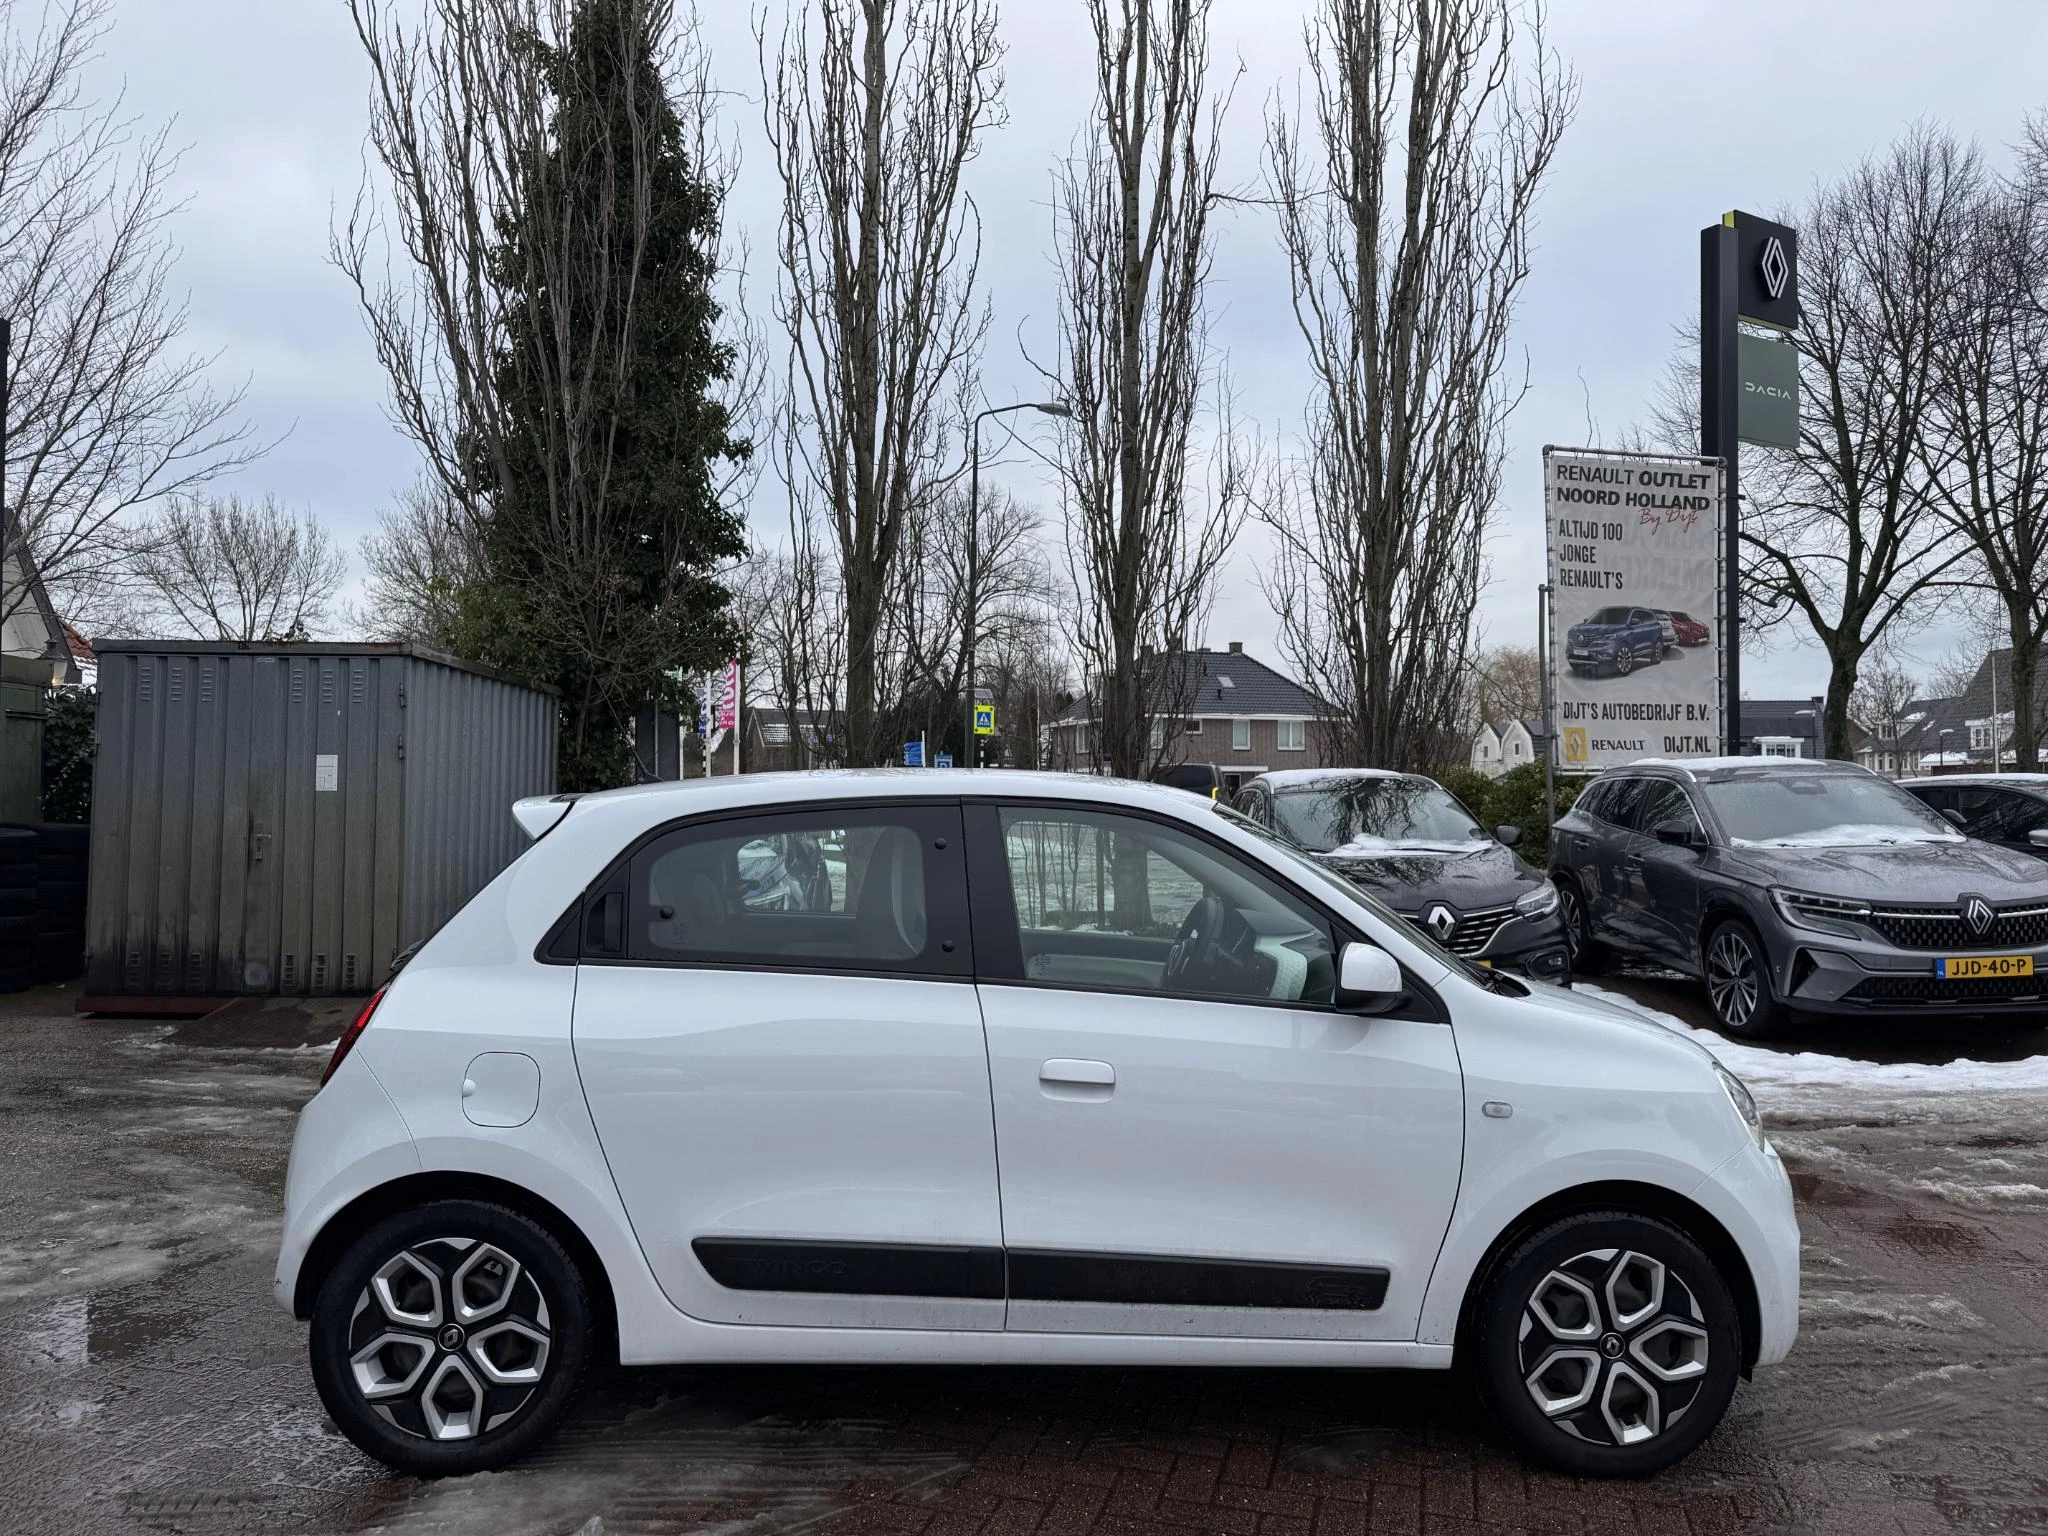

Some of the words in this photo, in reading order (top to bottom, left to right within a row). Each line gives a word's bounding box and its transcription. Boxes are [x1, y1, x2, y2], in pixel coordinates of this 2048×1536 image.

[1745, 381, 1791, 400] DACIA
[1557, 464, 1634, 485] RENAULT
[1638, 470, 1711, 490] OUTLET
[1557, 487, 1620, 506] NOORD
[1625, 491, 1710, 511] HOLLAND
[1559, 519, 1599, 540] ALTIJD
[1602, 522, 1623, 541] 100
[1638, 508, 1662, 535] By
[1559, 544, 1596, 564] JONGE
[1560, 568, 1623, 590] RENAULT'S
[1563, 701, 1599, 720] DIJT'S
[1602, 702, 1682, 721] AUTOBEDRIJF
[1686, 703, 1710, 721] B.V.
[1592, 739, 1645, 751] RENAULT
[1664, 735, 1712, 754] DIJT.NL
[1951, 958, 2027, 976] JJD-40-P
